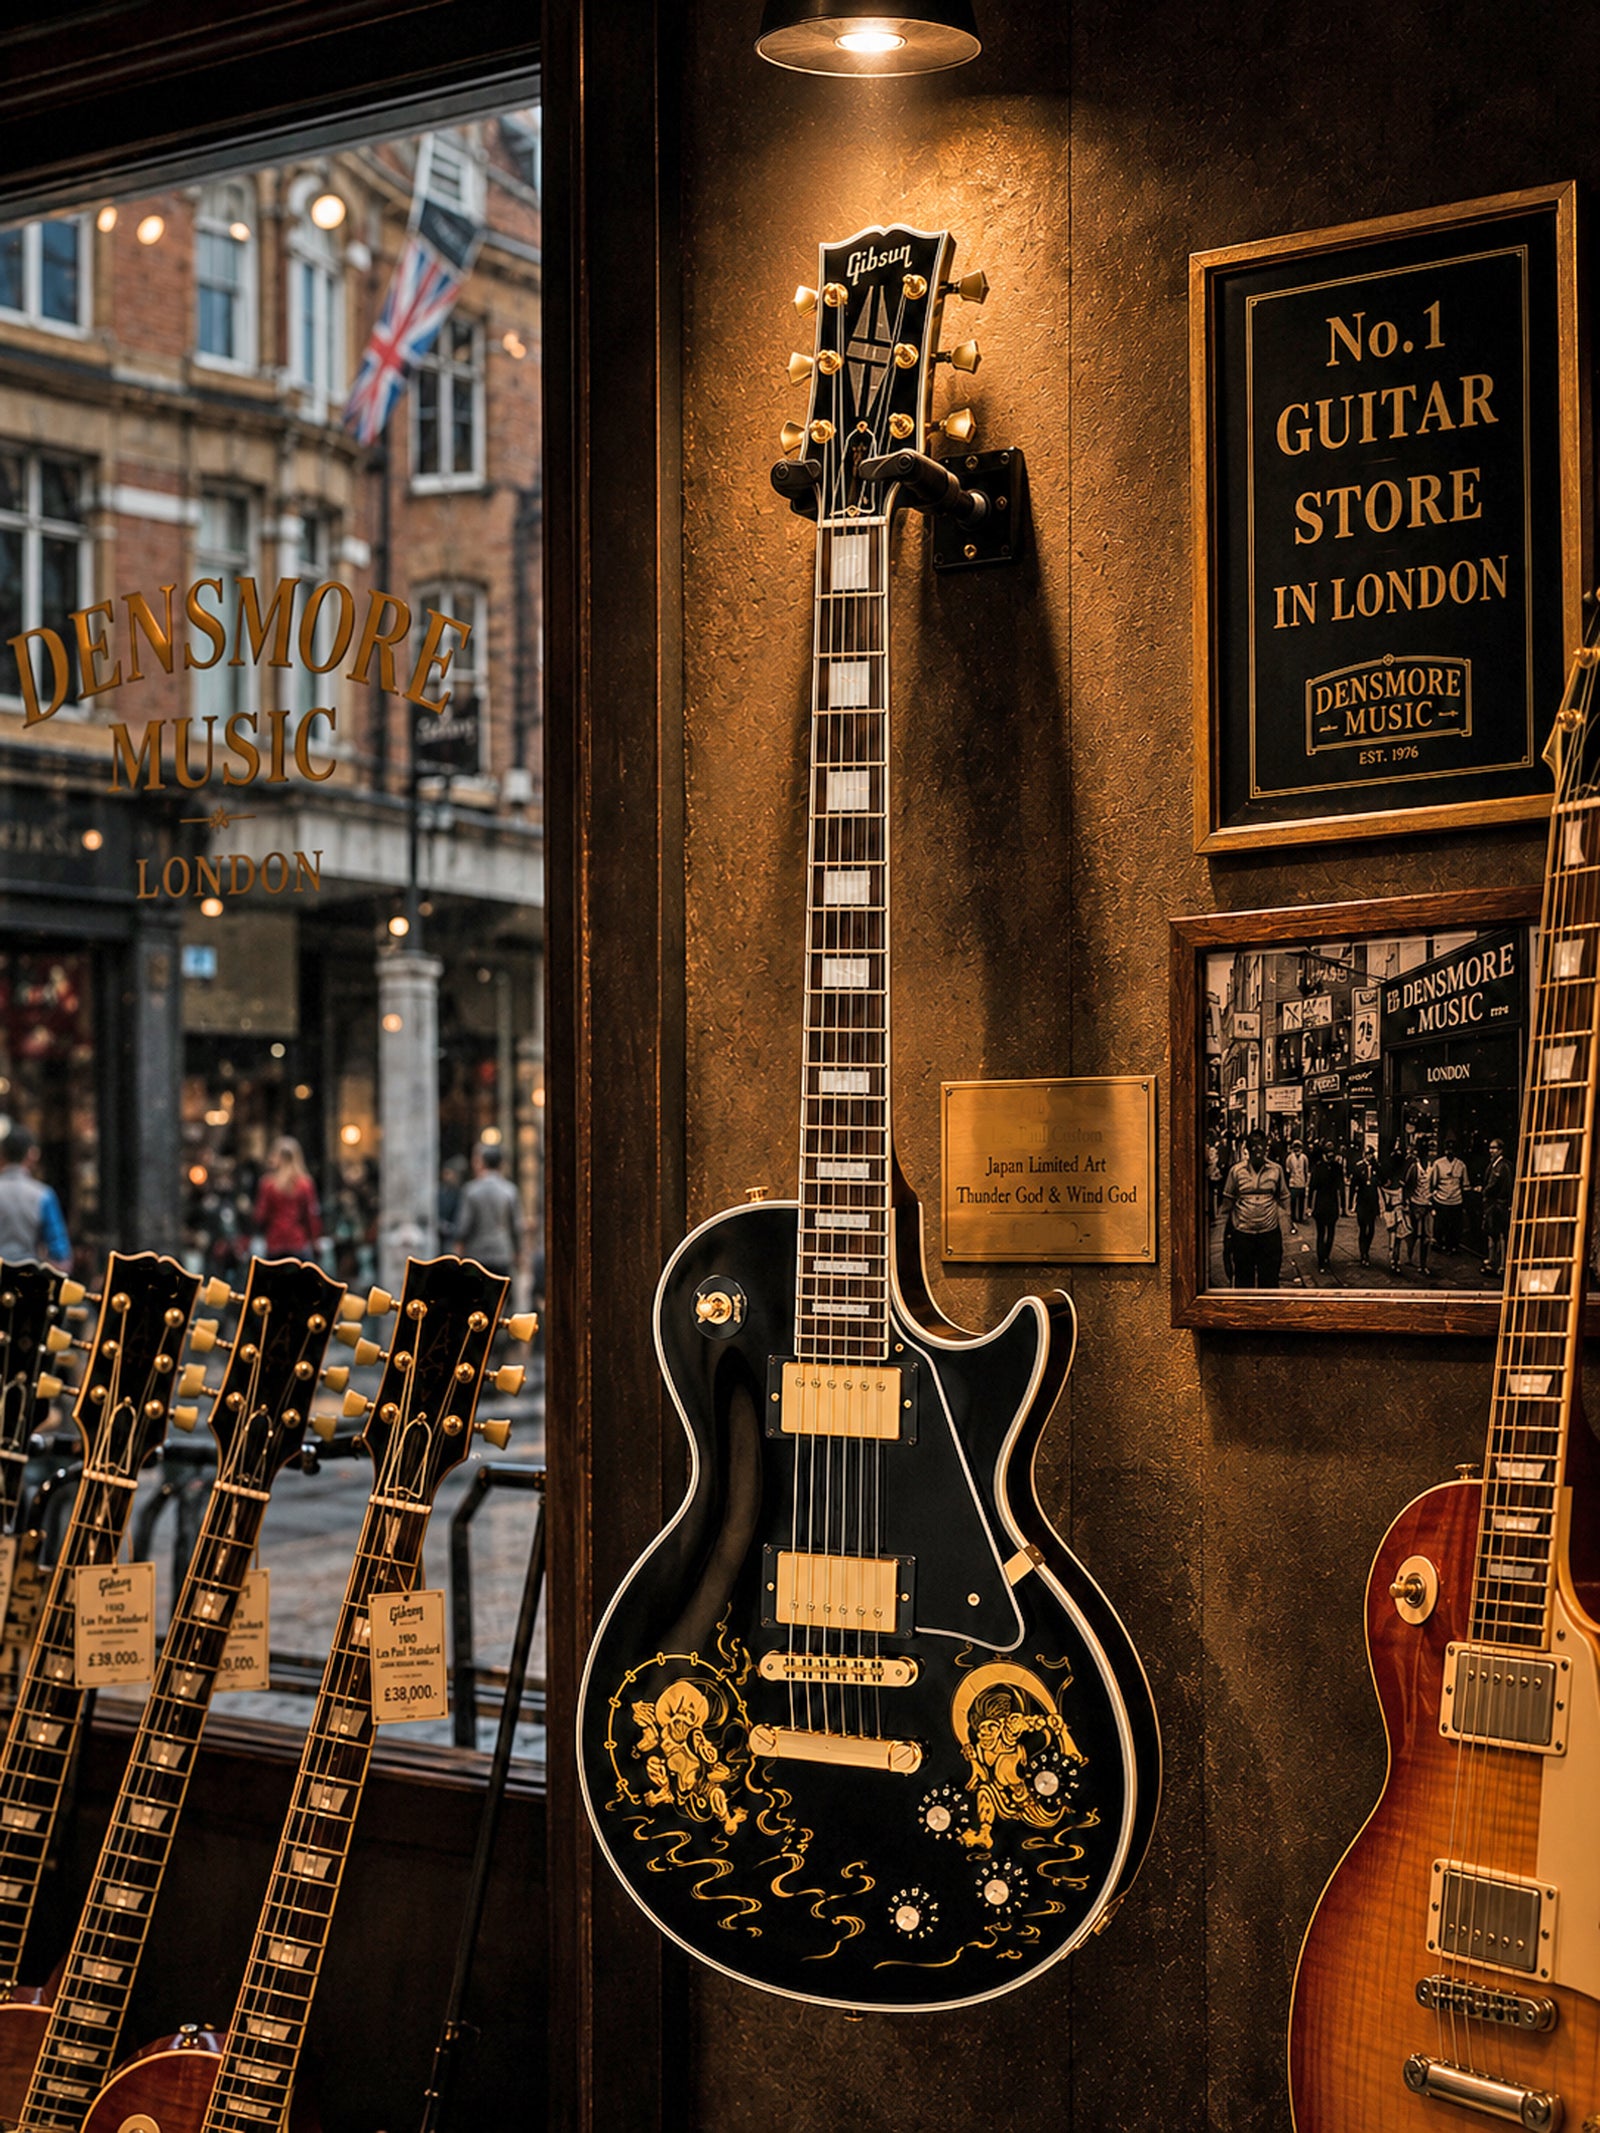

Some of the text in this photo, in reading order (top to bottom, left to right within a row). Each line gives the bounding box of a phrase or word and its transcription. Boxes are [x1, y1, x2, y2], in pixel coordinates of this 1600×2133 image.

[1325, 300, 1446, 367] No.1
[1276, 373, 1499, 456] GUITAR
[1294, 467, 1482, 545] STORE
[1273, 555, 1509, 629] IN LONDON
[6, 577, 472, 729] DENSMORE
[1315, 667, 1461, 715] DENSMORE
[1344, 701, 1433, 736] MUSIC
[107, 707, 337, 793] MUSIC
[1359, 746, 1419, 765] EST. 1976
[136, 850, 324, 899] LONDON
[1403, 942, 1515, 1009] DENSMORE
[1418, 992, 1484, 1034] MUSIC
[1427, 1063, 1471, 1082] LONDON
[985, 1155, 1107, 1178] Japan Limited Art
[956, 1185, 1137, 1204] Thunder God & Wind God
